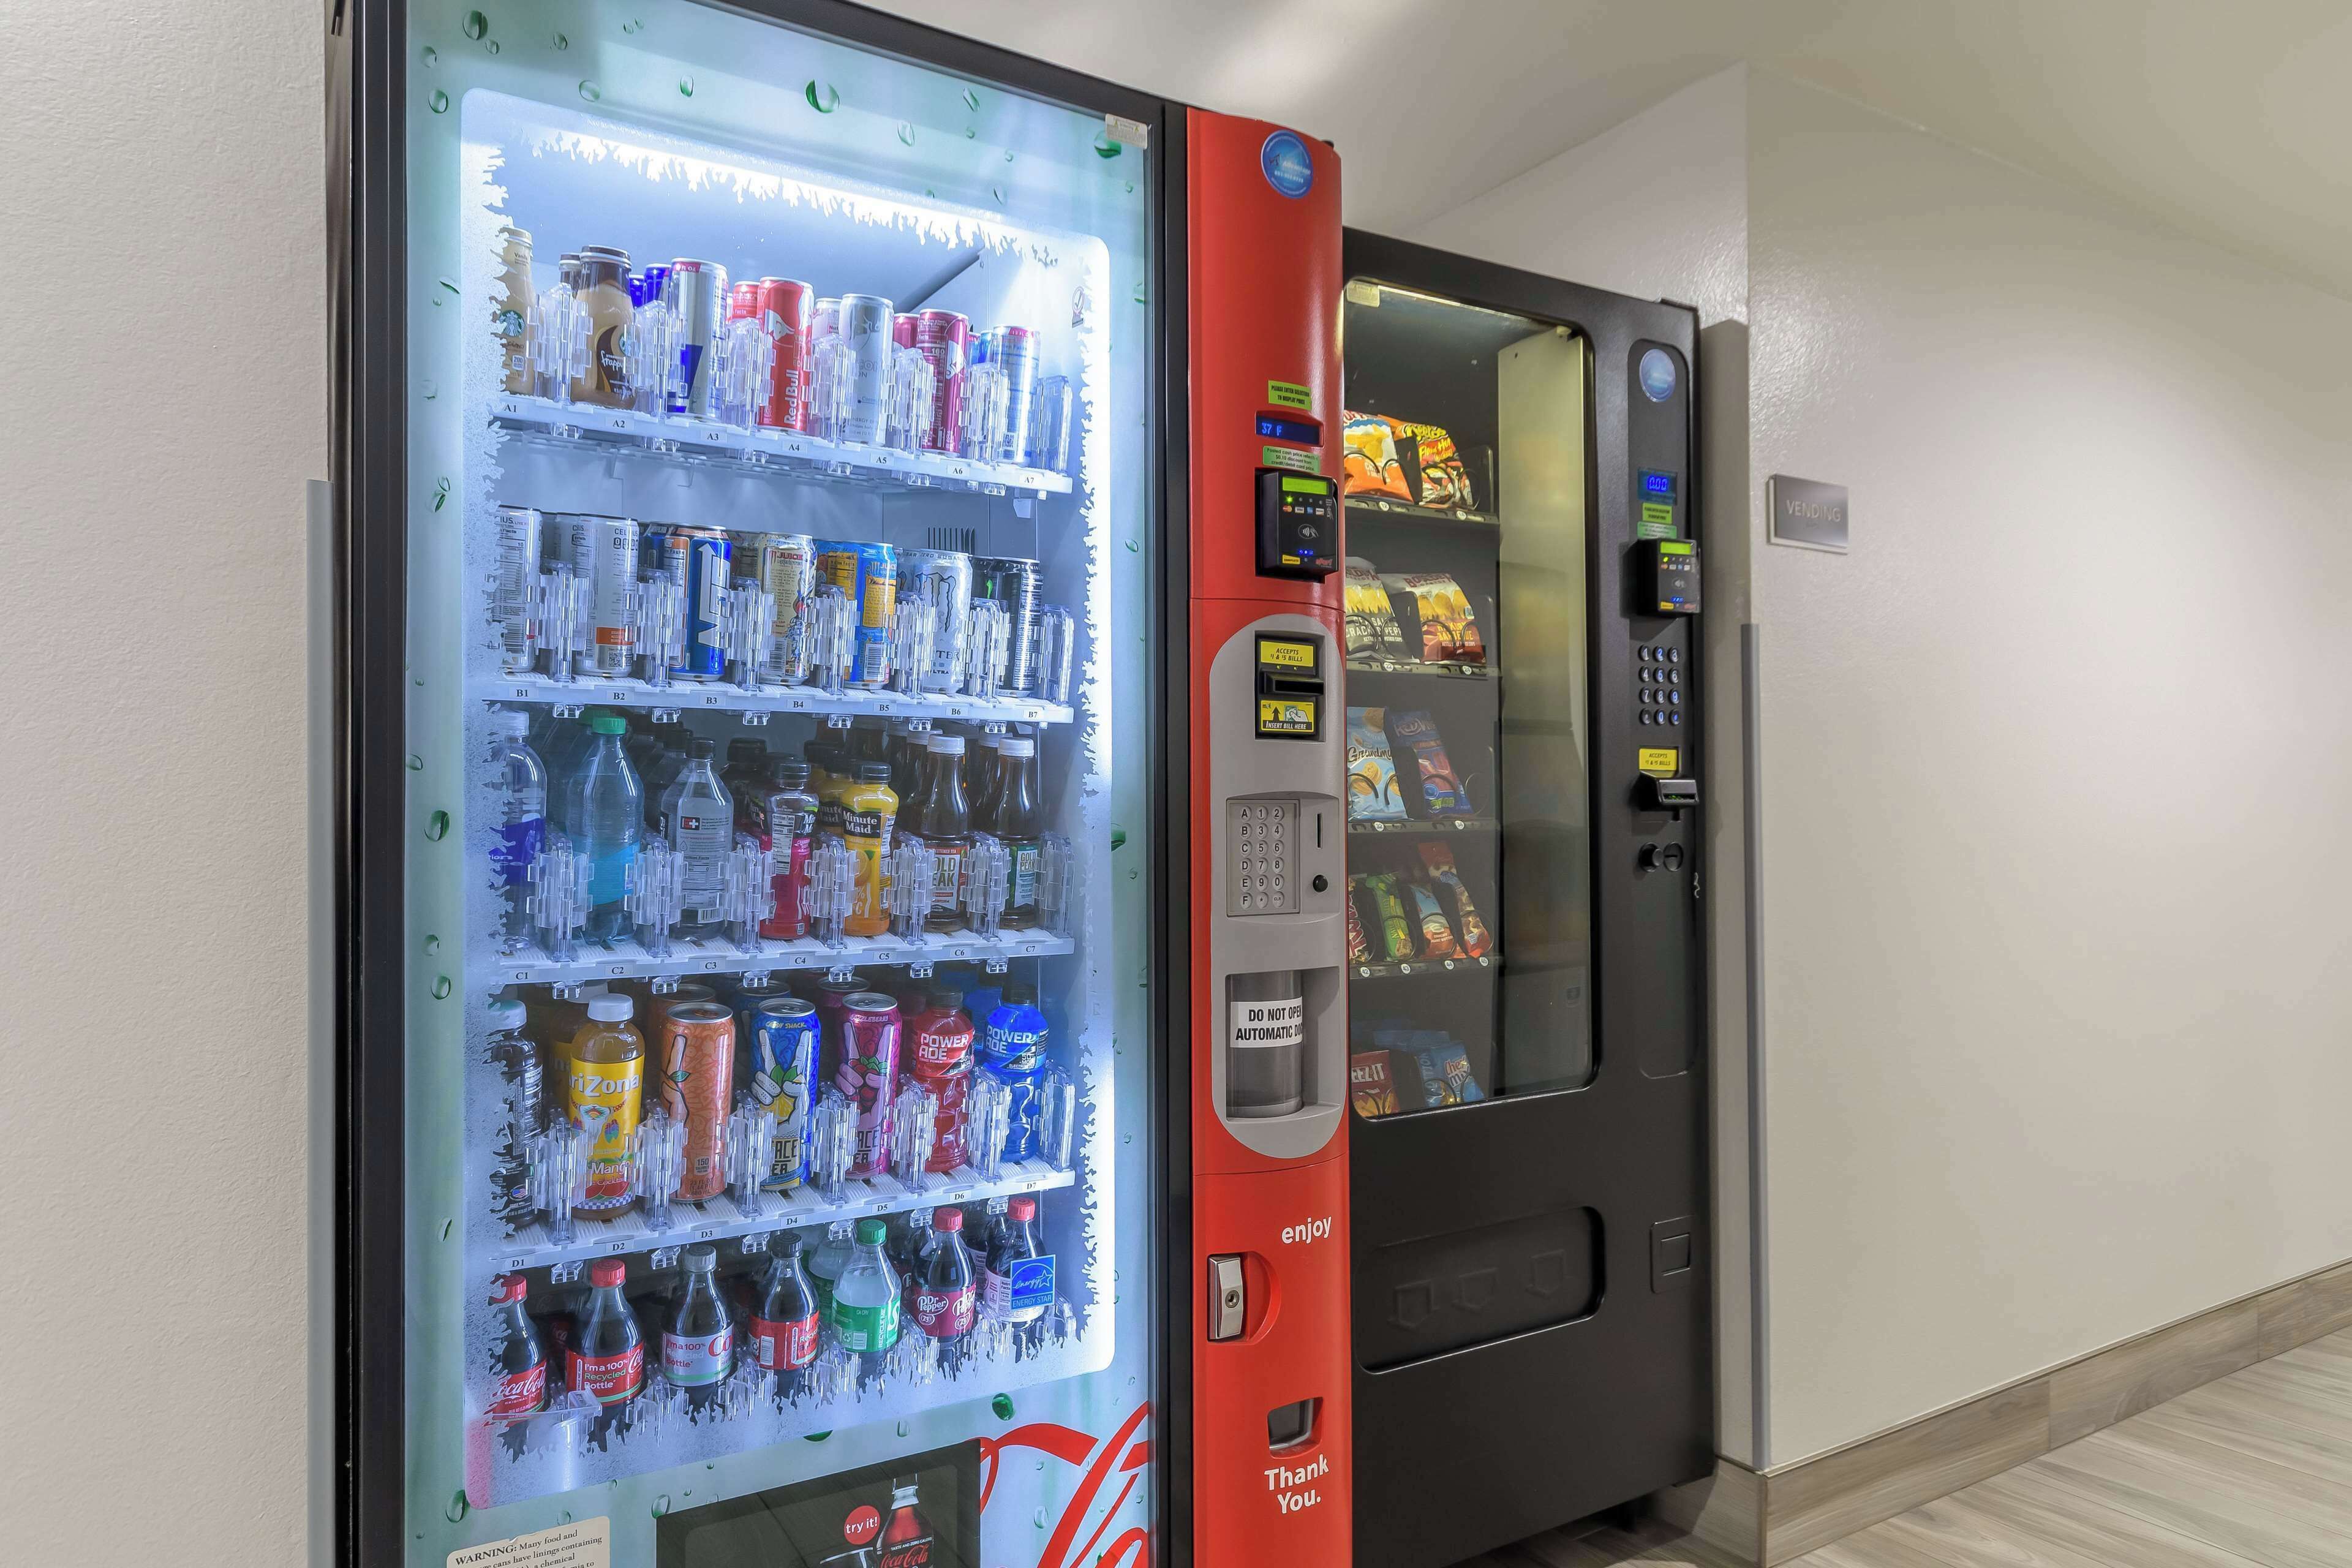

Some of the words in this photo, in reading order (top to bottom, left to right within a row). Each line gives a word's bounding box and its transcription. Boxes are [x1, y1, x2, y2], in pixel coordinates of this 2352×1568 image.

[786, 369, 799, 396] Bull
[504, 404, 518, 413] A1
[784, 398, 797, 424] Red
[1262, 423, 1272, 434] 37
[1276, 425, 1282, 436] F
[1785, 499, 1841, 522] VENDING
[516, 689, 529, 698] B1
[843, 810, 877, 825] Minute
[1242, 809, 1248, 818] A
[1259, 809, 1262, 817] 1
[846, 823, 872, 834] Maid
[1242, 826, 1248, 835] B
[1242, 843, 1248, 853] C
[1259, 843, 1264, 852] 5
[1020, 853, 1036, 862] GOLD
[1242, 861, 1248, 870] D
[1275, 861, 1280, 869] 8
[1243, 878, 1248, 887] E
[1259, 878, 1264, 886] 9
[1243, 896, 1248, 905] F
[795, 956, 806, 965] C4
[516, 971, 529, 980] C1
[1248, 1009, 1264, 1022] DO
[1267, 1008, 1286, 1022] NOT
[987, 1025, 1033, 1044] POWER
[1235, 1025, 1293, 1041] AUTOMATIC
[921, 1033, 969, 1048] POWER
[986, 1036, 1008, 1054] ADE
[919, 1045, 948, 1060] ADE
[569, 1073, 639, 1097] riZona
[1281, 1216, 1332, 1245] enjoy
[918, 1296, 946, 1313] Pepper
[927, 1295, 938, 1304] Dr
[1012, 1297, 1036, 1308] ENERGY
[1037, 1294, 1052, 1303] STAR
[880, 1308, 886, 1318] ME
[585, 1363, 598, 1371] I'm
[584, 1368, 626, 1381] Recycled
[1264, 1453, 1329, 1491] Thank
[1277, 1488, 1321, 1514] You.
[846, 1520, 863, 1535] try
[864, 1516, 878, 1529] it!
[455, 1545, 518, 1566] WARNING:
[519, 1540, 542, 1552] Many
[545, 1534, 562, 1545] food
[564, 1529, 578, 1540] and
[492, 1559, 511, 1568] cans
[513, 1554, 531, 1563] have
[533, 1547, 560, 1559] linings
[562, 1536, 603, 1551] containing
[540, 1553, 575, 1568] chemical
